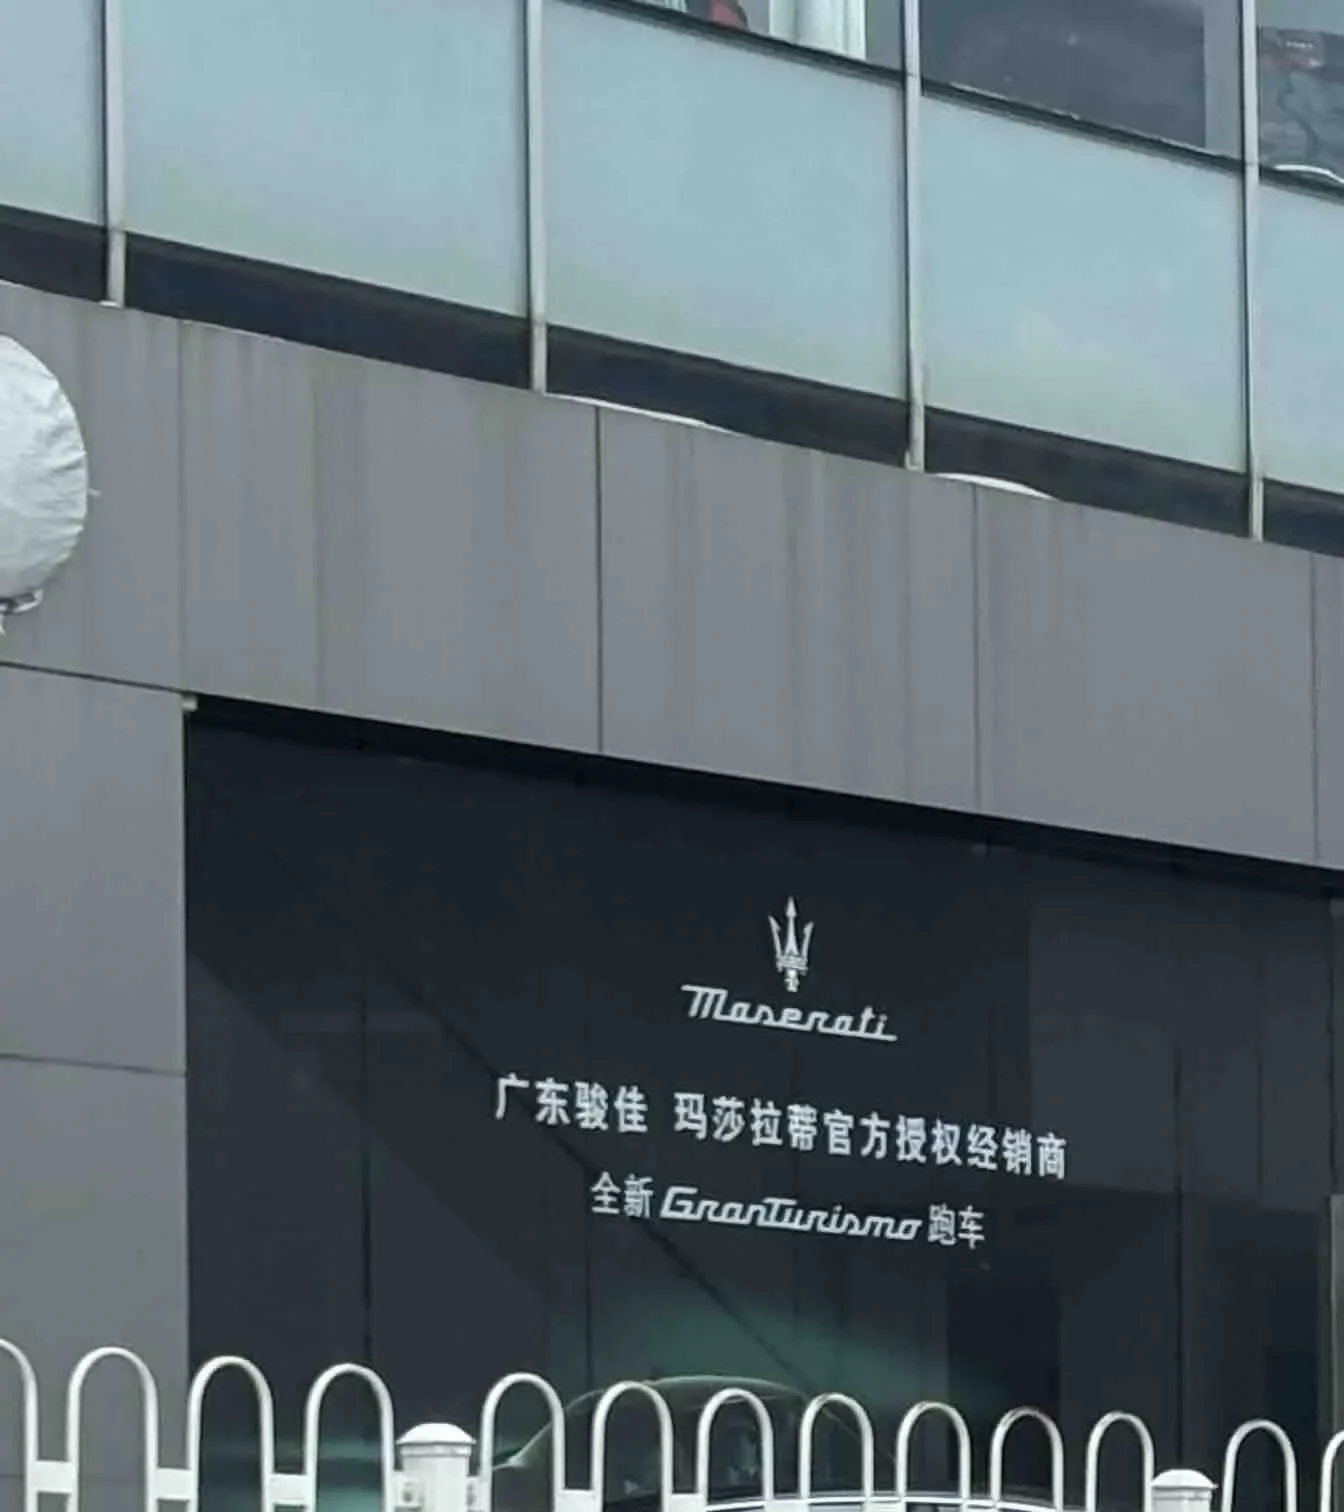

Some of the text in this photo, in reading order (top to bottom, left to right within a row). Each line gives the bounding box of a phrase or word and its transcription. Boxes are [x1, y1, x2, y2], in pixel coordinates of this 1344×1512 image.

[680, 984, 898, 1042] Maserati
[494, 1072, 1068, 1180] 广东骏佳 玛莎拉蒂官方授权经销商
[590, 1170, 986, 1250] 全新 GranTurismo 跑车
